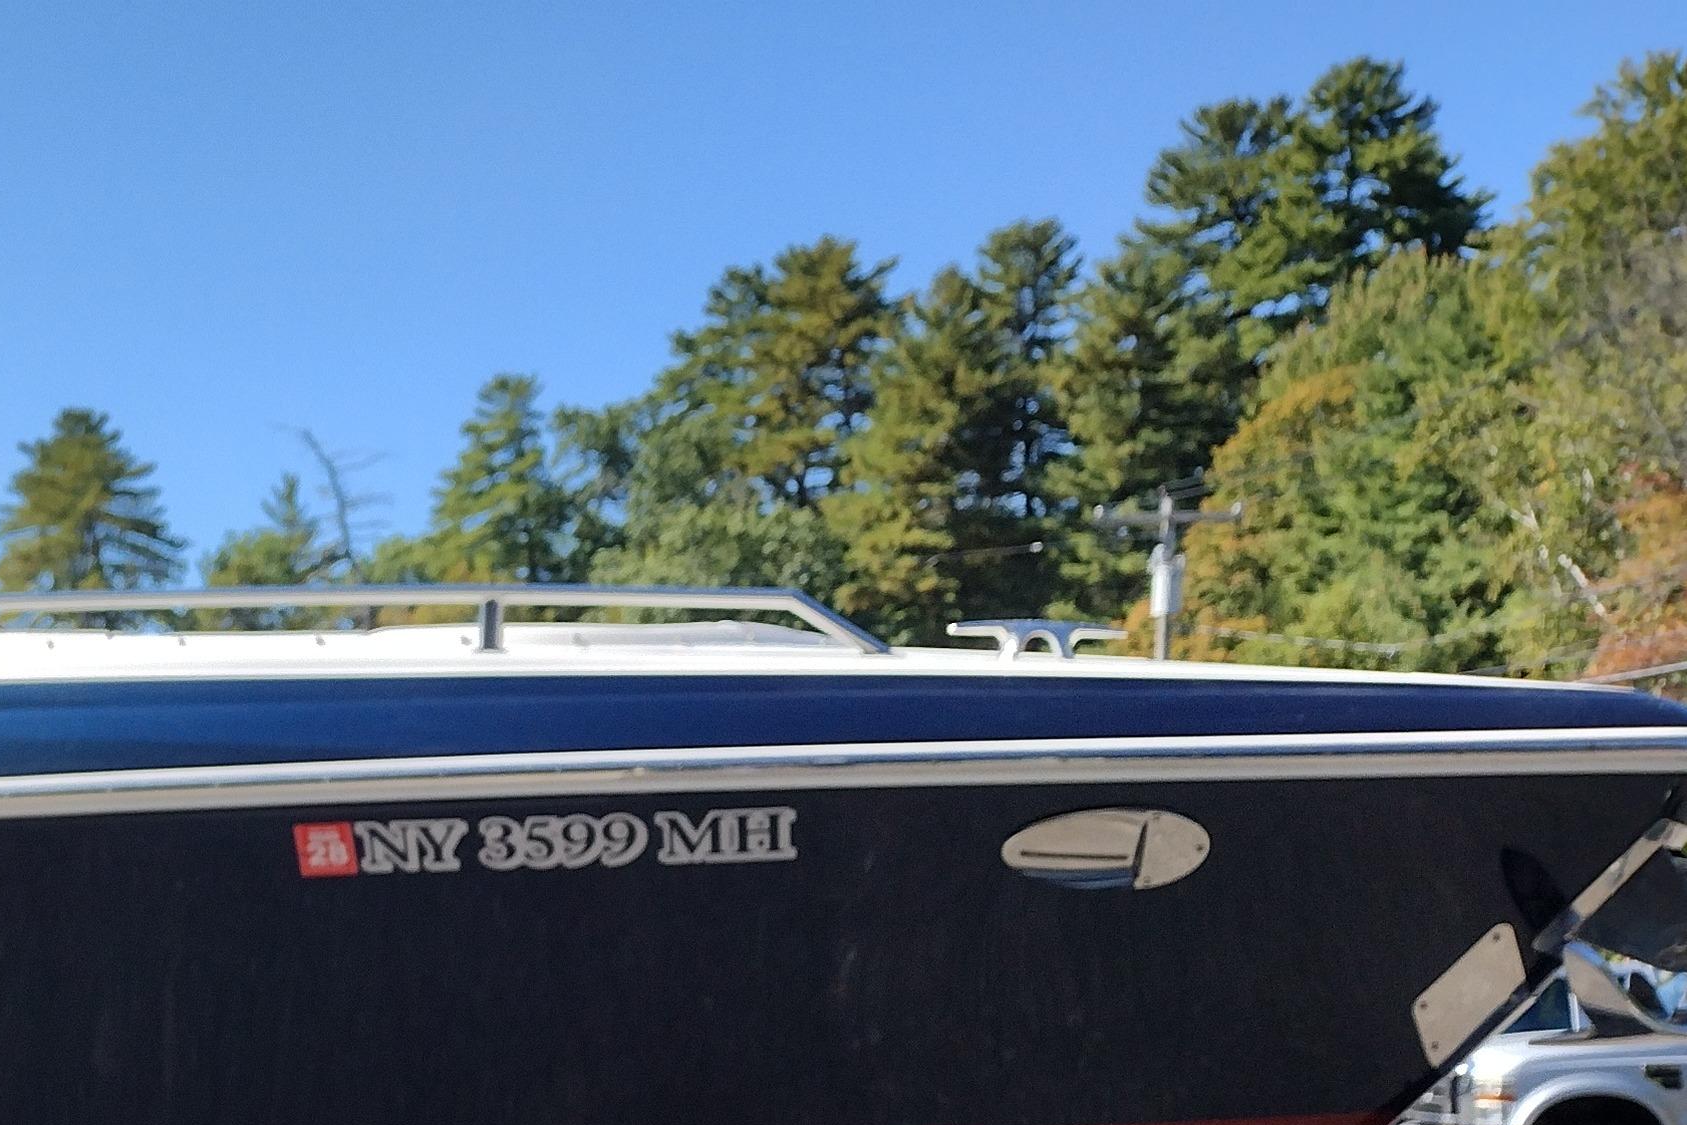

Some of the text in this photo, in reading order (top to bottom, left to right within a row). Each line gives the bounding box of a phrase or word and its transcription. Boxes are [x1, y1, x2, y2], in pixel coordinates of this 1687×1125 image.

[354, 806, 798, 874] NY 3599 MH
